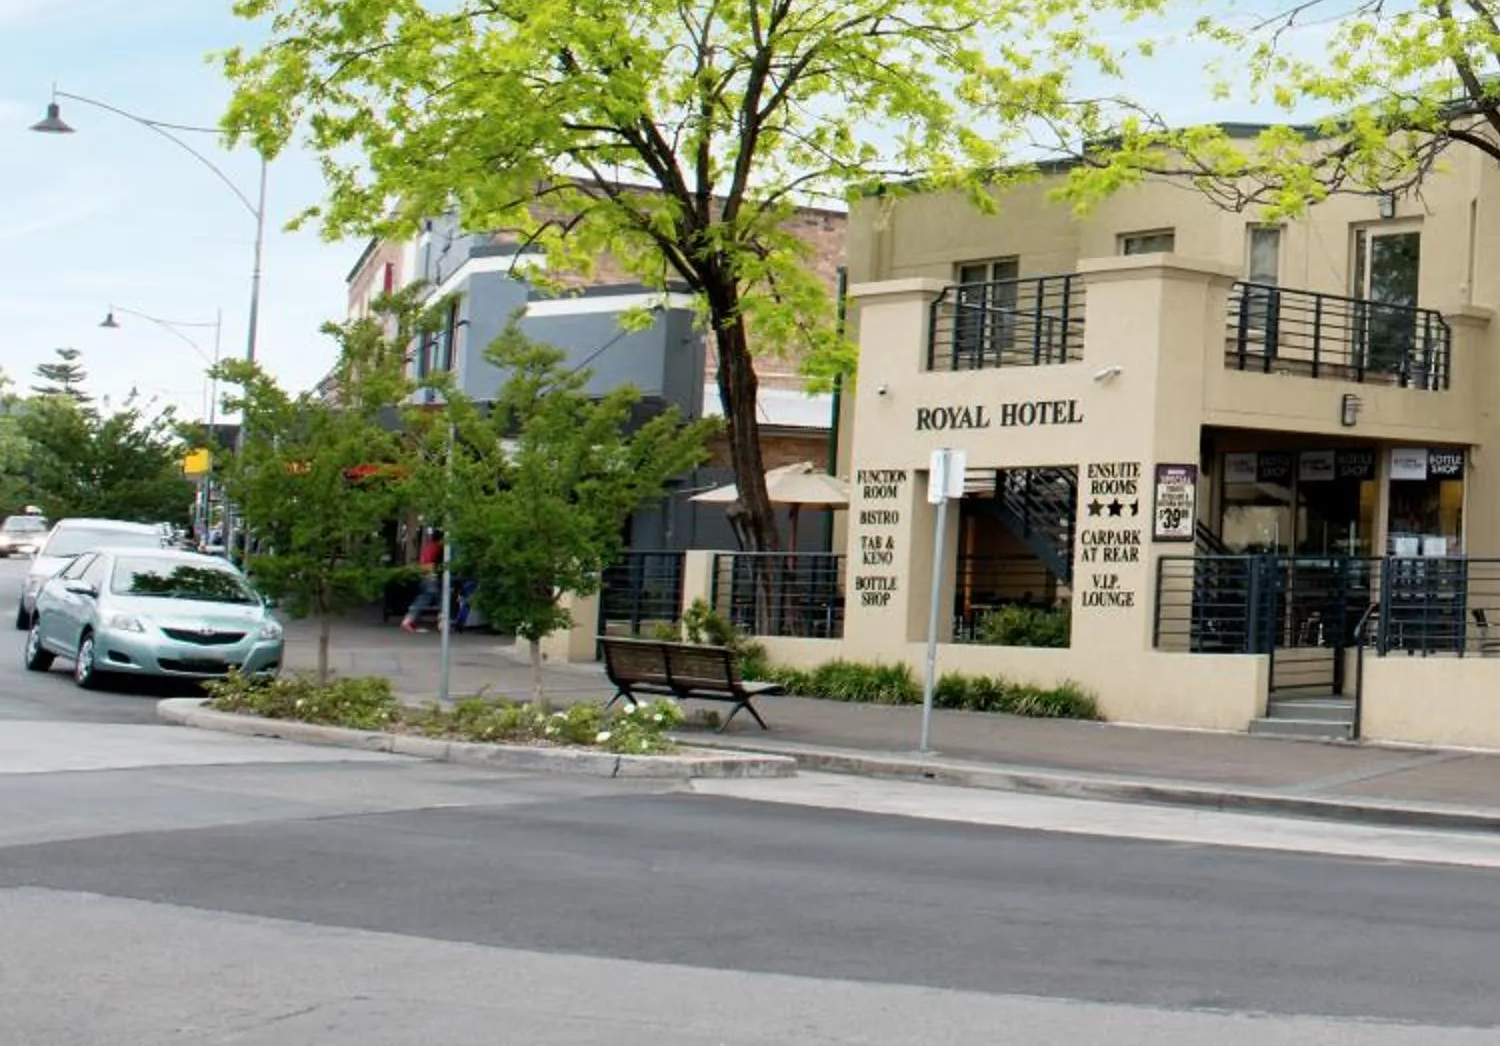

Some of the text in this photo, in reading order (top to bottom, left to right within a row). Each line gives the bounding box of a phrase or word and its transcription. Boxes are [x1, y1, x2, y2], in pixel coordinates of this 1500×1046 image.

[916, 400, 1084, 431] ROYAL HOTEL
[1430, 454, 1462, 465] BOTTLE
[857, 469, 907, 484] FUNCTION
[1087, 462, 1141, 479] ENSUITE
[1431, 464, 1458, 474] SHOP
[863, 485, 897, 499] ROOM
[1091, 479, 1137, 495] ROOMS
[860, 510, 900, 525] BISTRO
[861, 535, 895, 550] TAB &
[1081, 529, 1141, 545] CARPARK
[862, 551, 893, 565] KENO
[1081, 547, 1140, 563] AT REAR
[855, 576, 897, 591] BOTTLE
[861, 591, 891, 607] SHOP
[1081, 591, 1135, 607] LOUNGE
